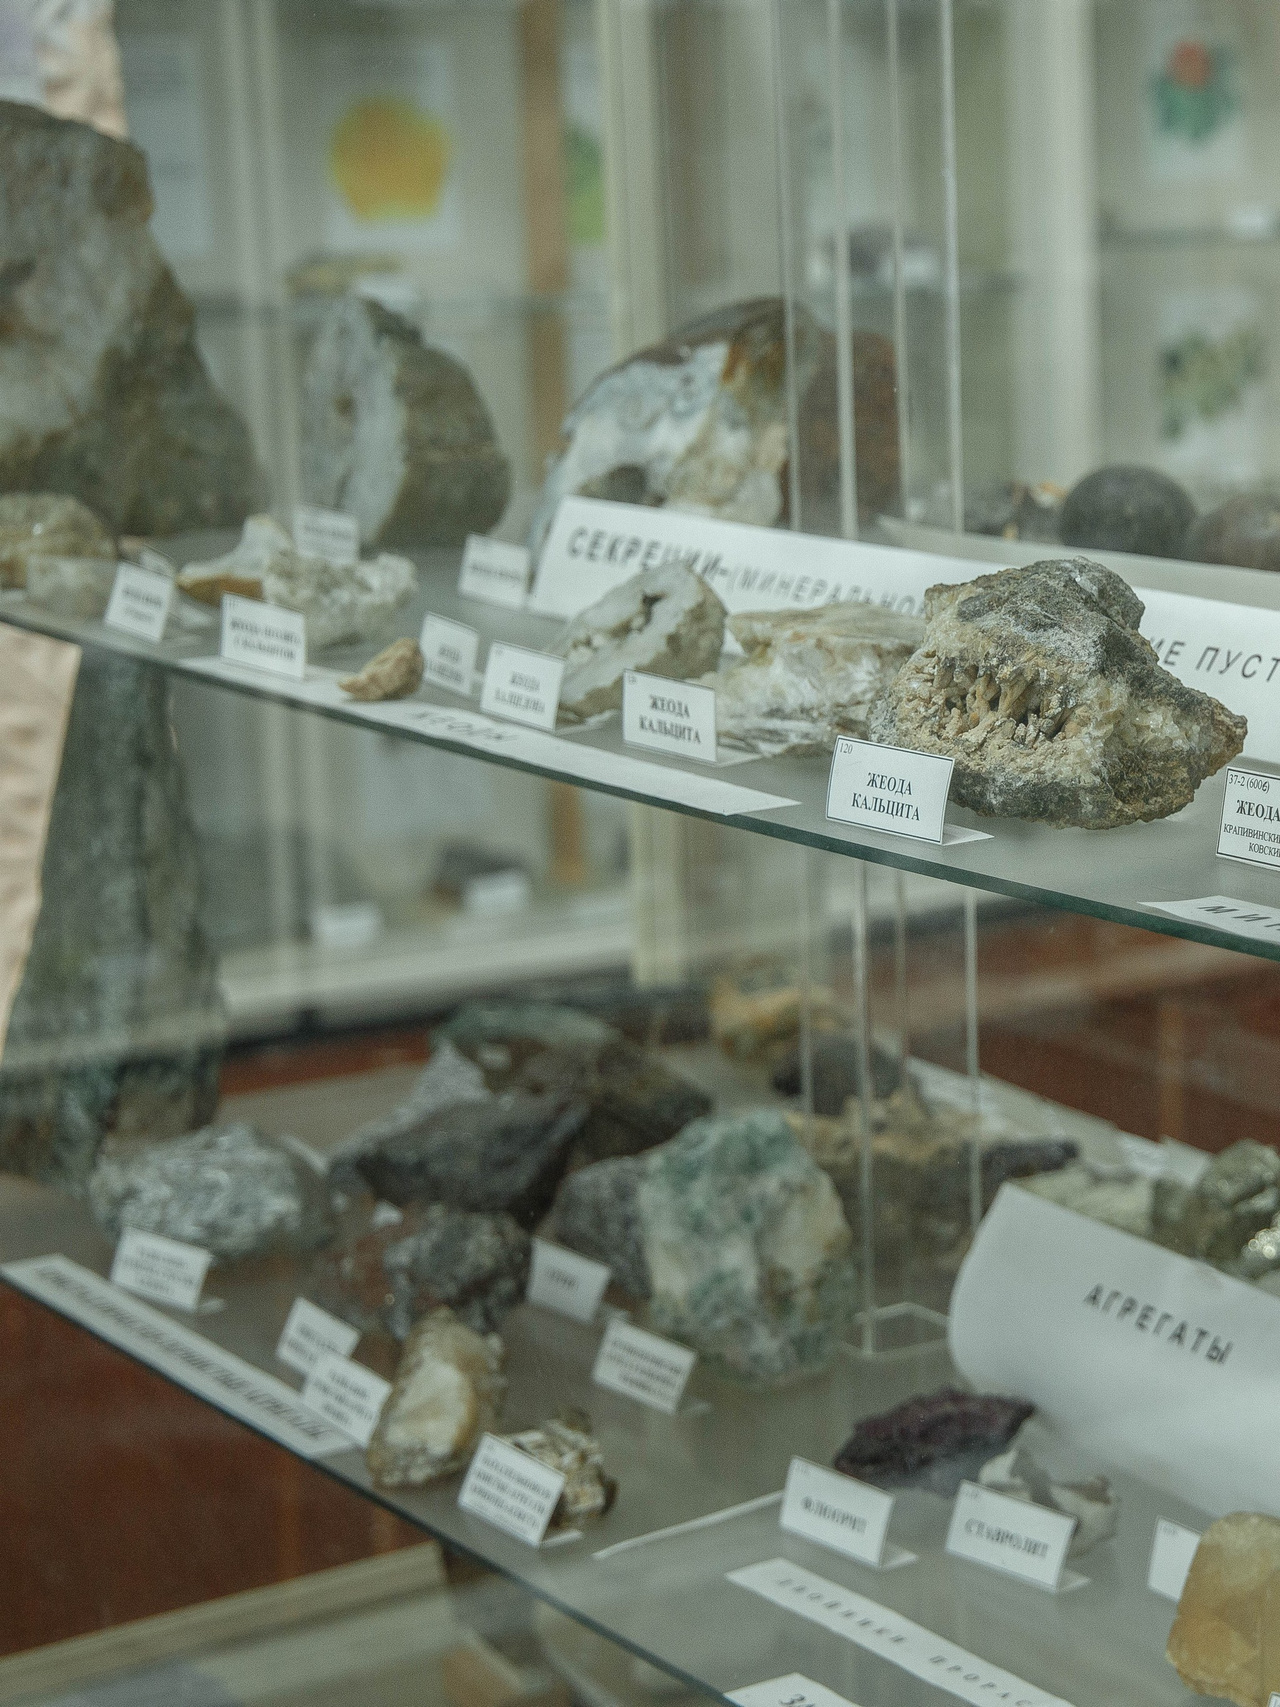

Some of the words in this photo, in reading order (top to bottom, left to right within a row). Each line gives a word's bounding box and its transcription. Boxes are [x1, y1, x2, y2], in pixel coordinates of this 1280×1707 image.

[648, 693, 691, 719] ЖЕОДА
[639, 714, 702, 744] КАЛЬЦИТА
[839, 742, 853, 755] 120
[866, 771, 912, 797] ЖЕОДА
[1228, 773, 1246, 787] 37-2
[1246, 777, 1270, 794] (6006)
[851, 792, 920, 821] КАЛЬЦИТА
[1236, 799, 1280, 823] ЖЕОДА
[1083, 1282, 1234, 1365] АГРЕГАТЫ
